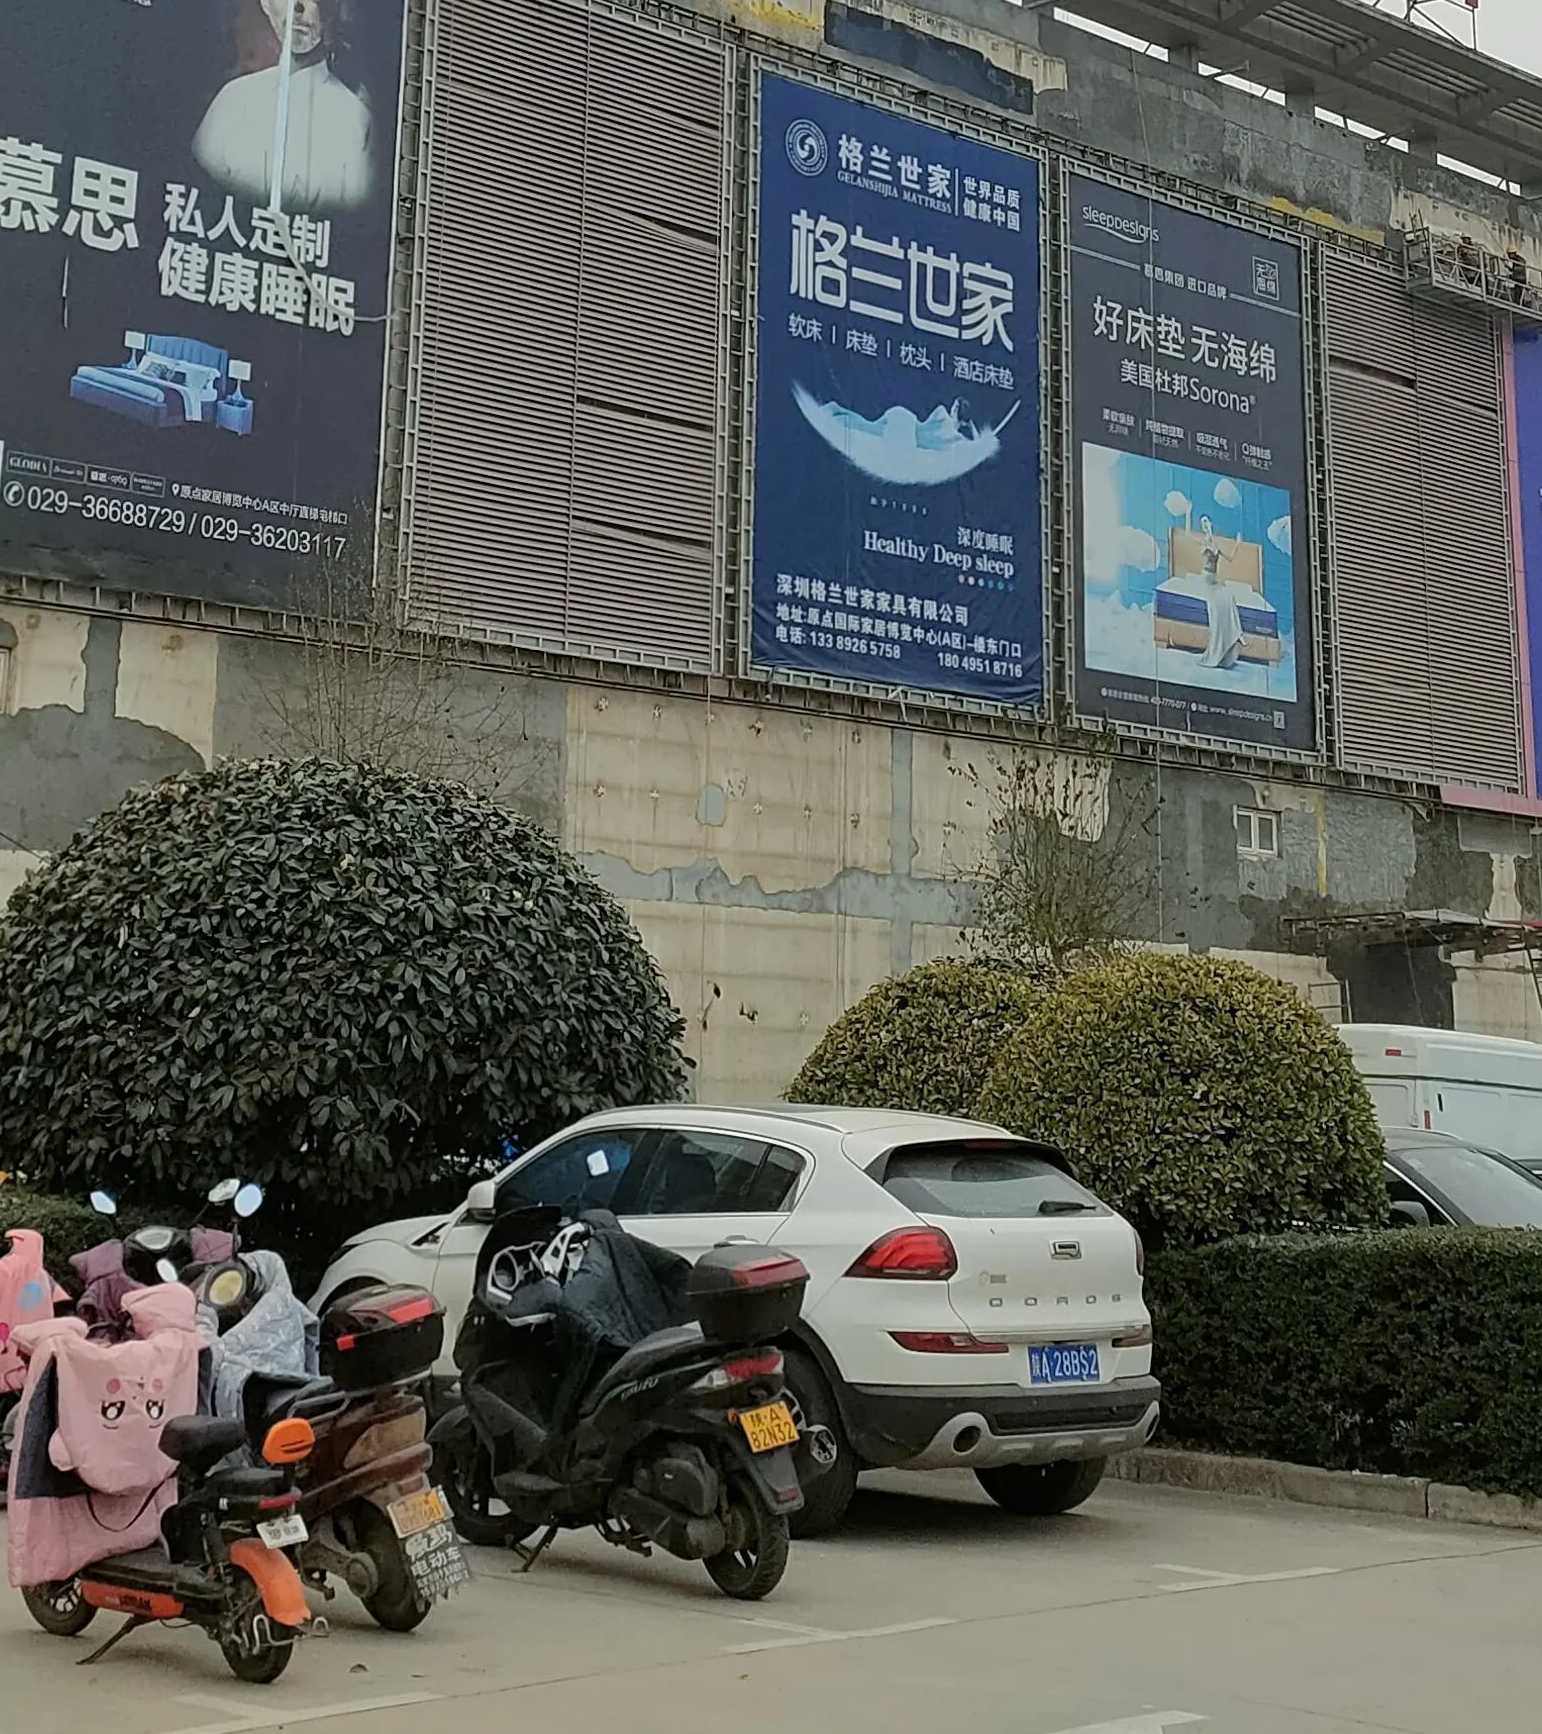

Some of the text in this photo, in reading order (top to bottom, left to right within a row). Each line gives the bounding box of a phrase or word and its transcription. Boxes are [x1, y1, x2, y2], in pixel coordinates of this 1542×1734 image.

[837, 133, 952, 200] 格兰世家
[837, 170, 952, 214] GELANSHIJIA MATTRESS
[962, 176, 1021, 210] 世界品质
[162, 182, 331, 268] 私人定制
[962, 197, 1021, 232] 健康中国
[158, 237, 355, 338] 健康睡眠
[789, 209, 1014, 353] 格兰世家
[788, 312, 1015, 390] 软床 床垫 枕头 酒店床垫
[1092, 295, 1277, 384] 好床垫 无海绵
[27, 486, 186, 534] 029-36688729
[200, 514, 347, 562] 029-36203117
[863, 529, 1015, 579] Healthy Deep sleep
[751, 1422, 796, 1450] 82N32
